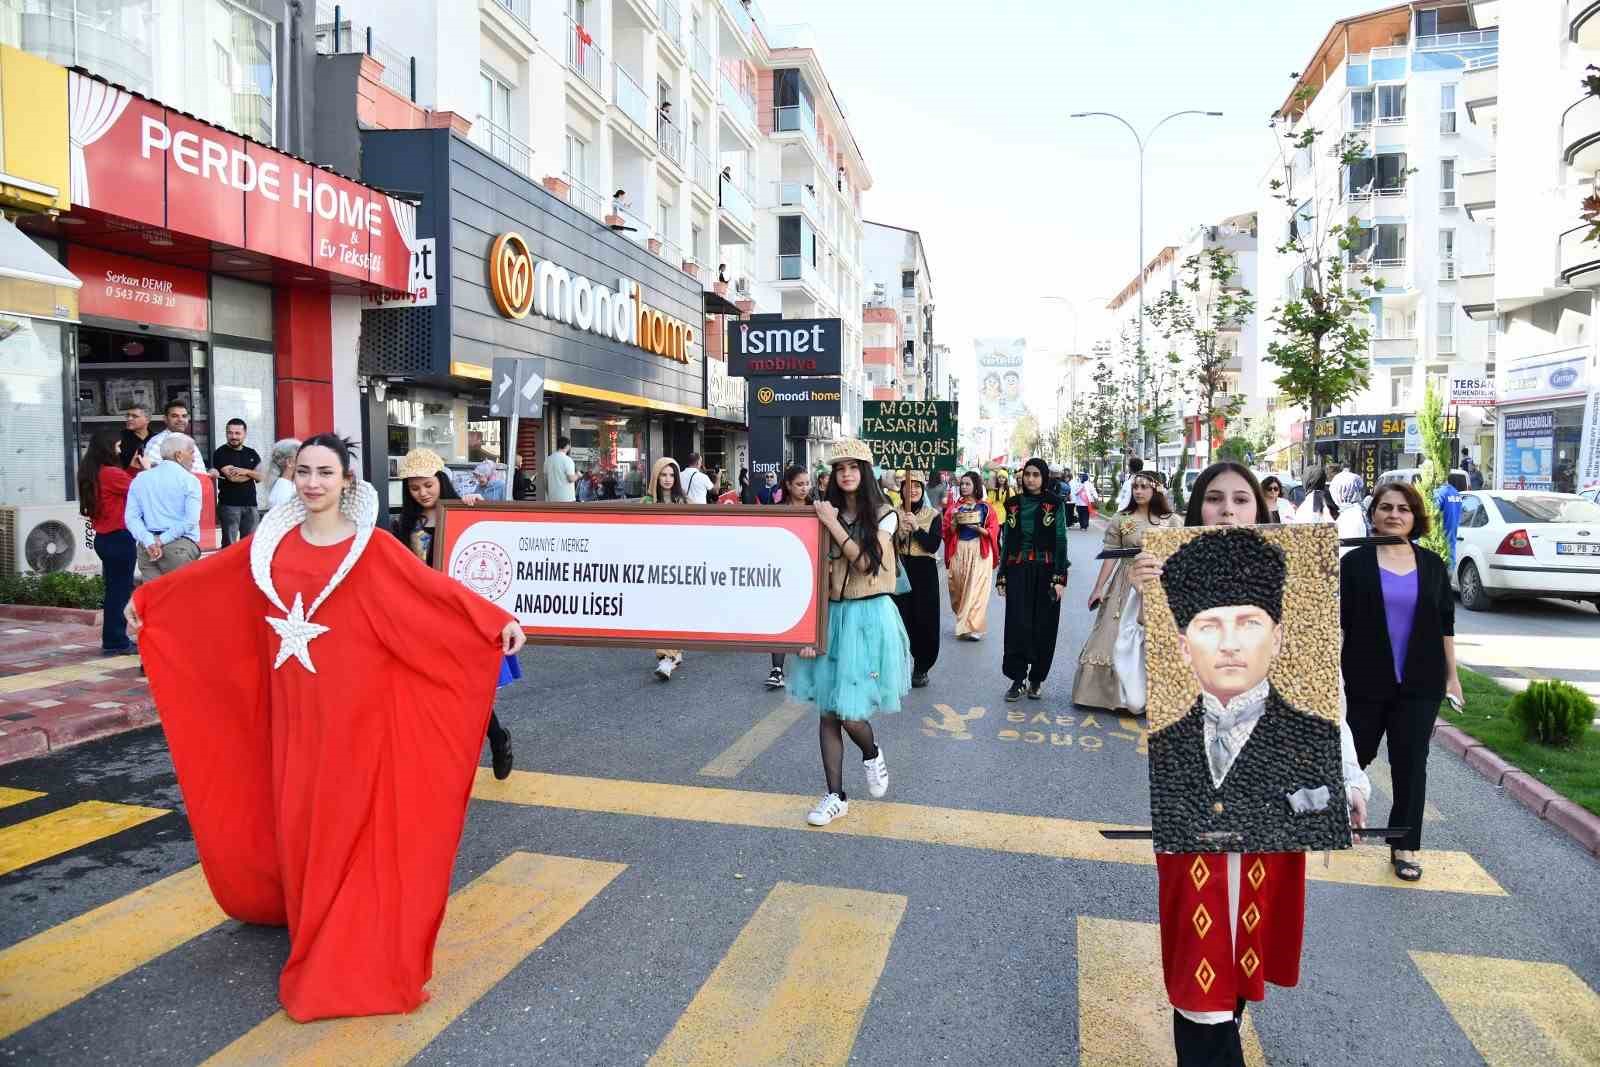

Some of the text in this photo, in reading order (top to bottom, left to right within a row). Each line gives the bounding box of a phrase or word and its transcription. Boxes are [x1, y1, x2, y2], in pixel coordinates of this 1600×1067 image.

[141, 115, 382, 236] PERDE HOME
[319, 238, 336, 258] Ev
[105, 270, 173, 293] Serkan DEMİR
[115, 287, 133, 300] 543
[775, 390, 840, 401] mondi home
[880, 401, 938, 416] MODA
[863, 417, 938, 433] TASARIM
[1343, 419, 1377, 436] EÇAN
[752, 460, 781, 473] ismet
[562, 537, 590, 553] MERKEZ
[516, 557, 570, 582] RAHİME
[572, 561, 619, 584] HATUN
[622, 563, 645, 585] KIZ
[647, 561, 707, 586] MESLEKİ
[710, 570, 726, 586] ve
[730, 563, 782, 588] TEKNİK
[514, 592, 624, 617] ANADOLU LİSESİ
